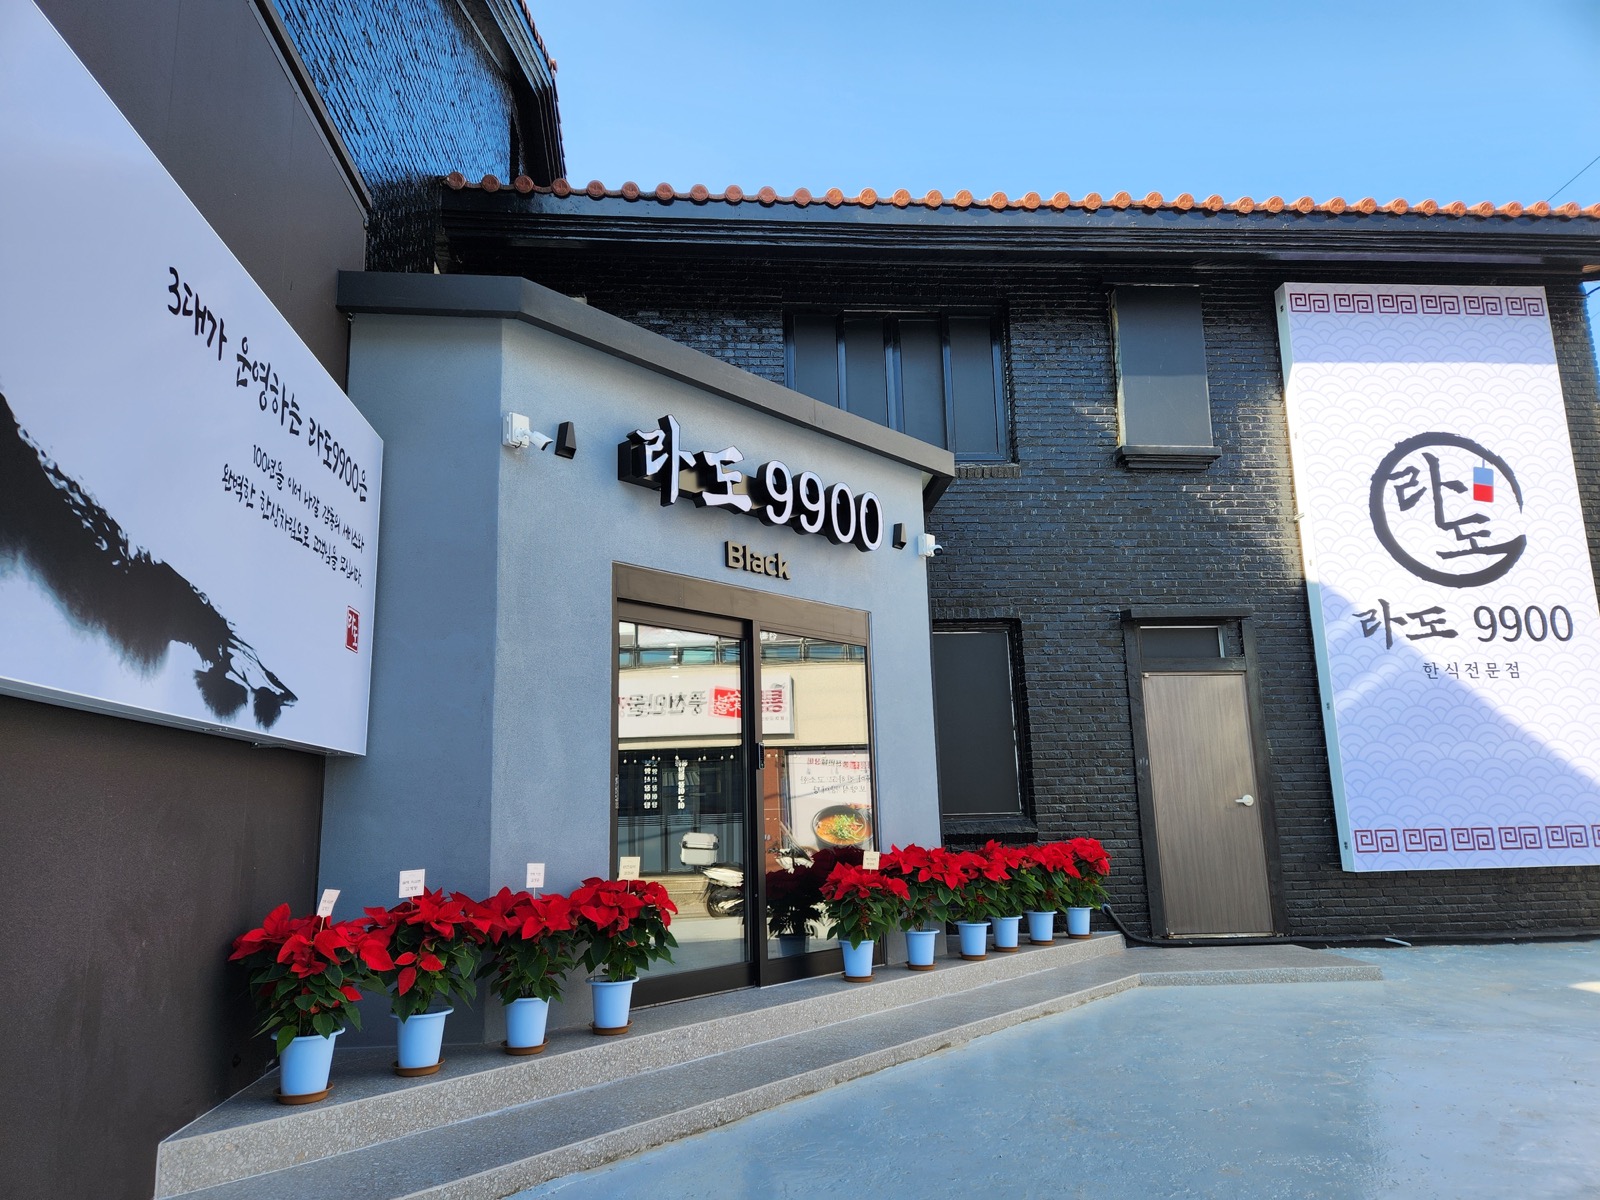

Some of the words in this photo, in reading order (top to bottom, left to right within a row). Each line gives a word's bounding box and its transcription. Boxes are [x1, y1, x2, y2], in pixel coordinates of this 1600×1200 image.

[167, 266, 228, 361] 3대가
[236, 336, 302, 436] 운영하는
[308, 416, 368, 503] 라도9900은
[253, 444, 285, 491] 100년을
[288, 476, 302, 502] 이어
[303, 490, 320, 519] 나갈
[635, 413, 753, 513] 라도
[764, 459, 884, 552] 9900
[221, 463, 256, 509] 완벽한
[259, 490, 310, 549] 한상차림으로
[312, 534, 338, 571] 고객님을
[724, 540, 791, 580] Black
[346, 611, 359, 649] 라도
[1351, 598, 1459, 650] 라도
[1473, 605, 1574, 643] 9900
[1422, 661, 1521, 680] 한식전문점
